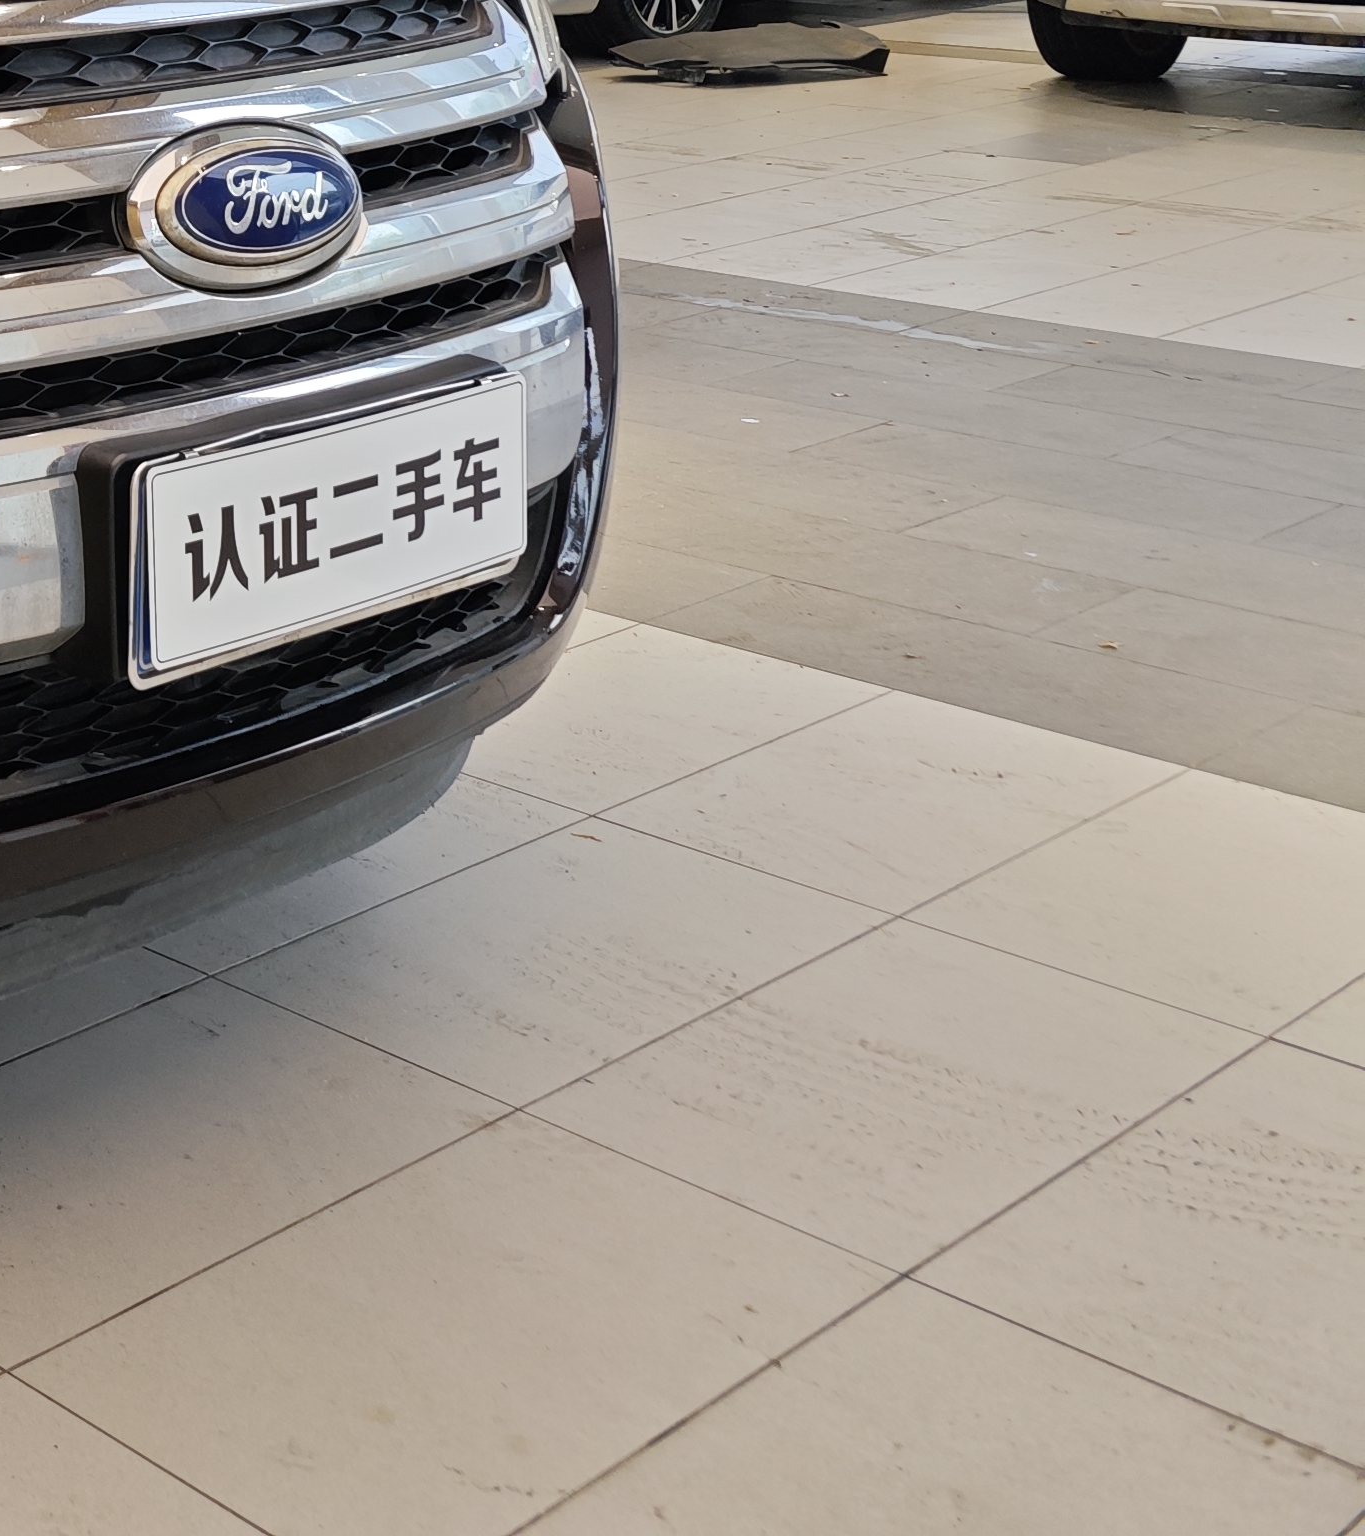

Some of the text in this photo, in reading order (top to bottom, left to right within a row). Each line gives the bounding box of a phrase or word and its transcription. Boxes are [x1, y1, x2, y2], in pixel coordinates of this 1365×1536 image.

[224, 160, 329, 235] Ford
[184, 437, 501, 601] 认证二手车
